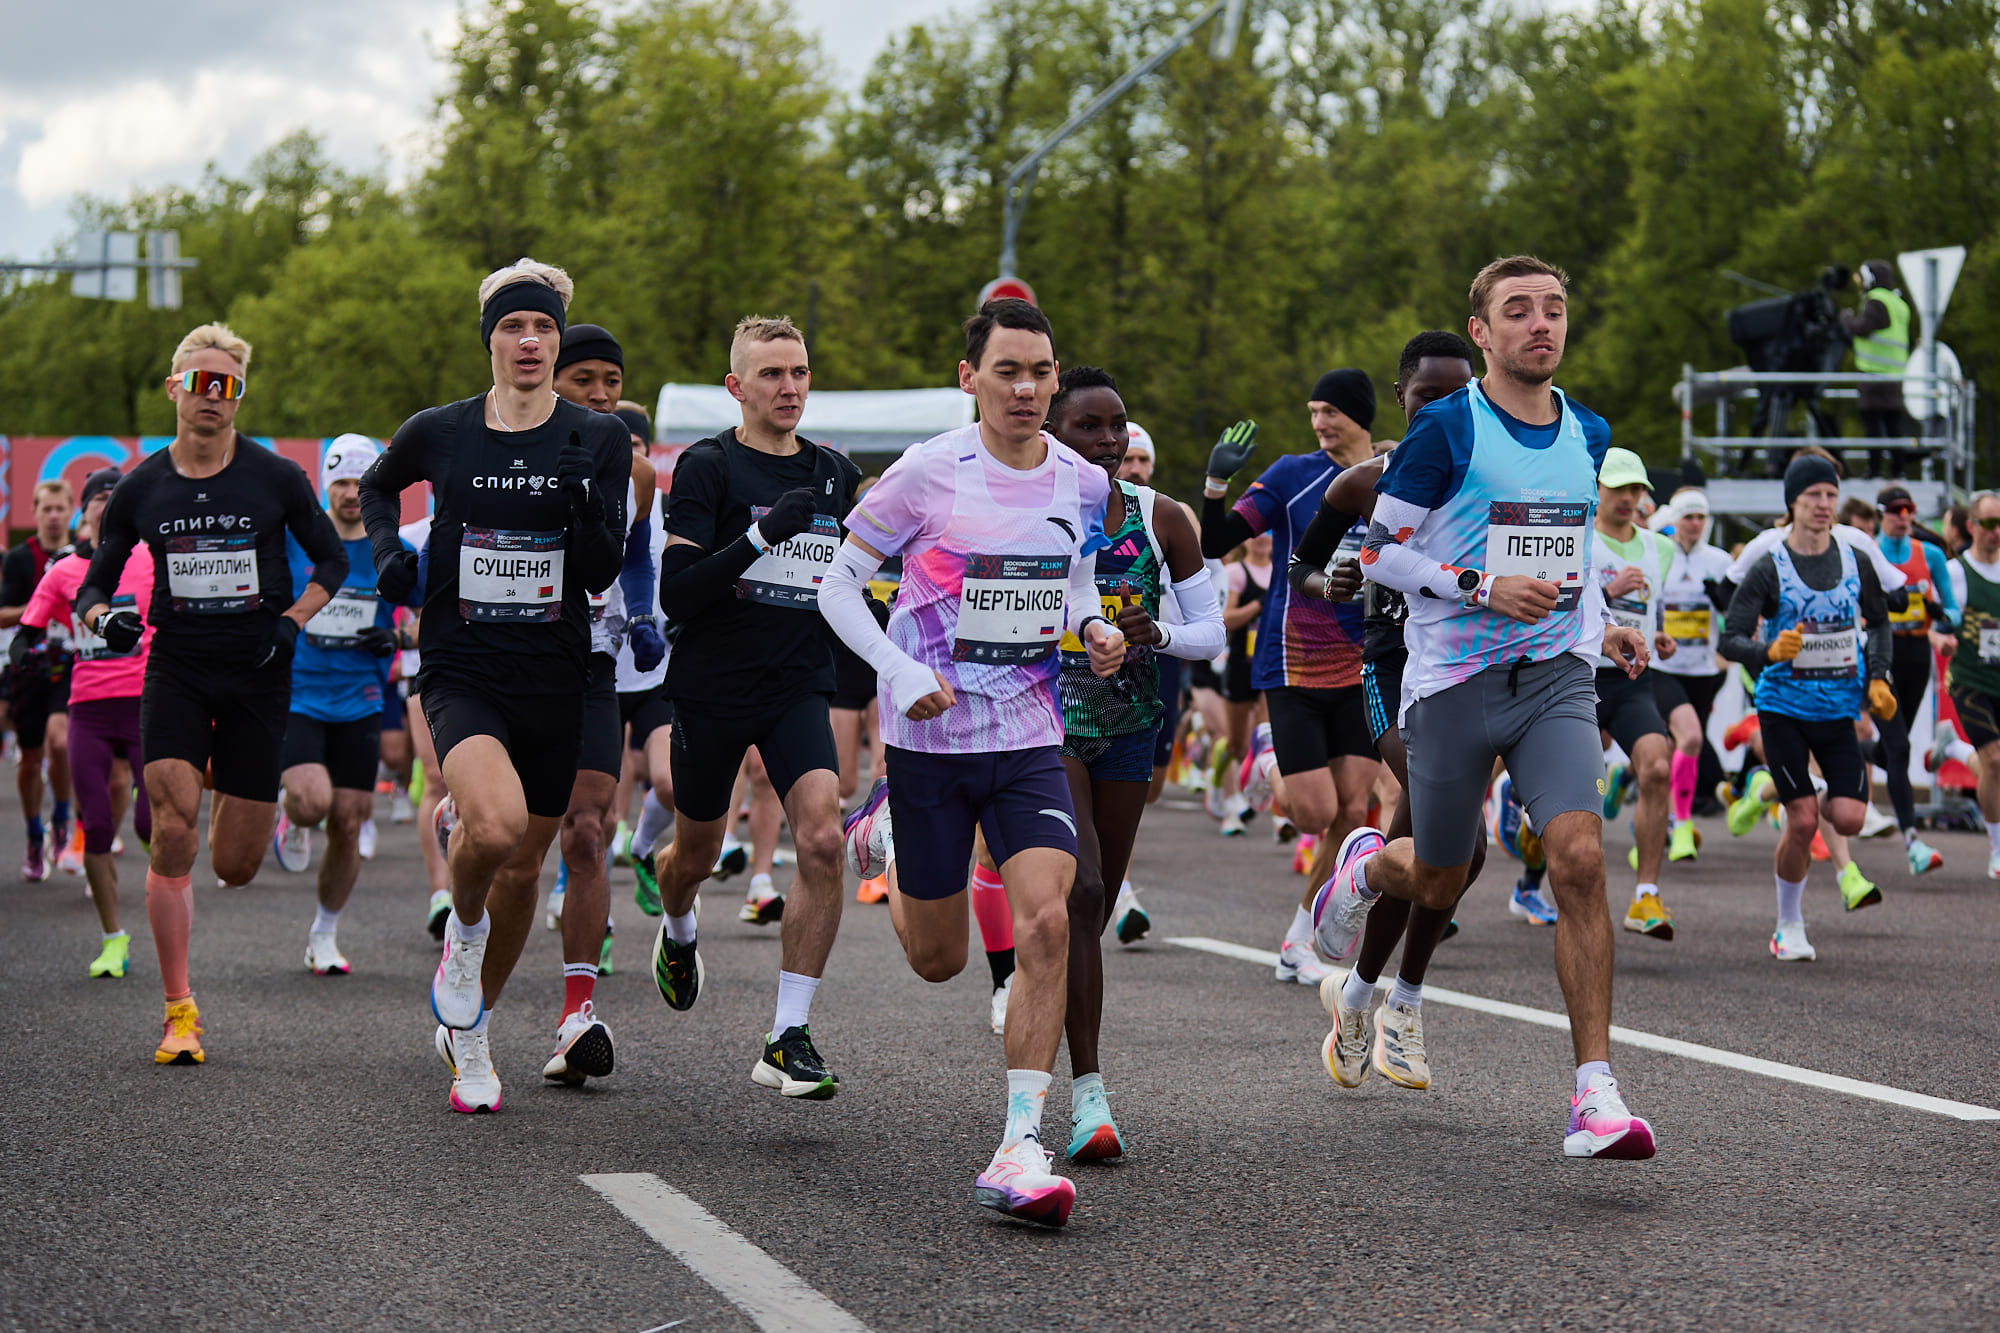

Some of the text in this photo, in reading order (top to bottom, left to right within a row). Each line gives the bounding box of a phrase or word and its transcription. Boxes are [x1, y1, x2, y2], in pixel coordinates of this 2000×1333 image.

[1507, 536, 1575, 557] ПЕТРОВ
[172, 557, 252, 576] ЗАЙНУЛЛИН
[473, 557, 551, 581] СУЩЕНЯ
[785, 571, 794, 579] 11
[1537, 571, 1547, 580] 40
[506, 589, 516, 597] 36
[965, 588, 1064, 611] ЧЕРТЫКОВ
[1012, 626, 1018, 634] 4
